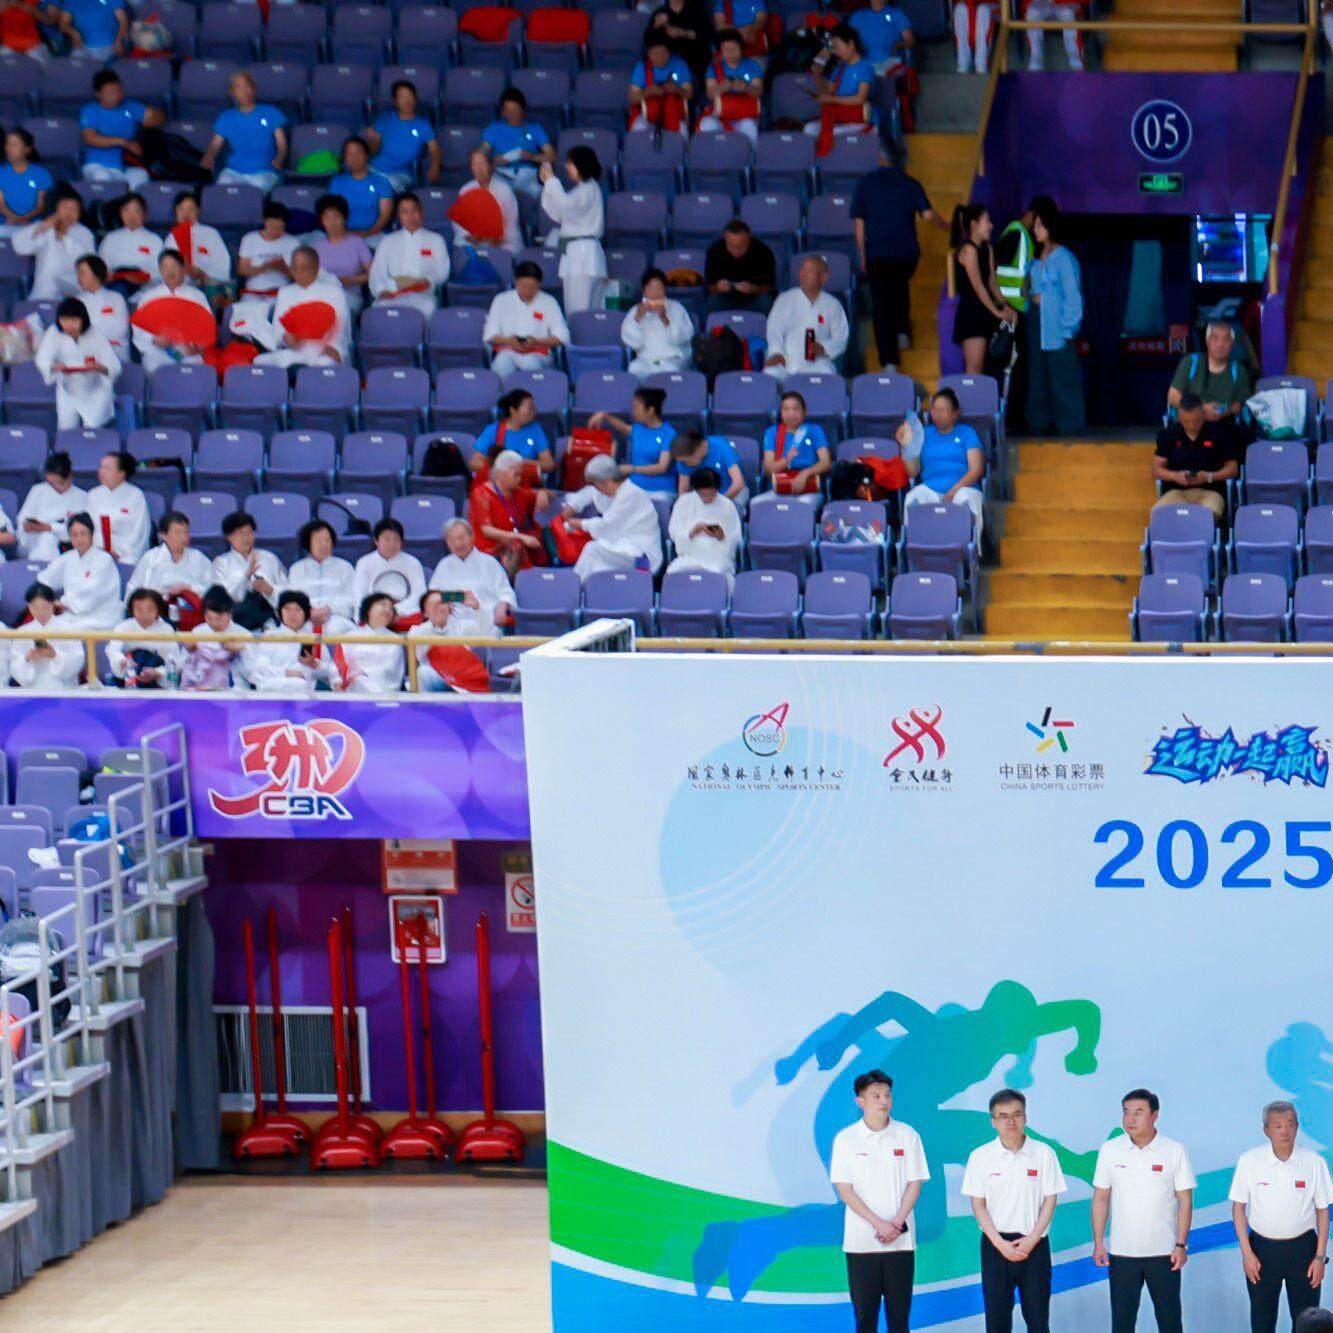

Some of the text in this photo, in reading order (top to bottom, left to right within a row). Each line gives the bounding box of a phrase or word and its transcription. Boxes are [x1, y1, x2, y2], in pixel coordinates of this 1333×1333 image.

[1143, 113, 1179, 150] 05
[1000, 764, 1105, 780] 中国体育彩票
[1001, 783, 1105, 791] CHINA SPORTS LOTTERY
[263, 795, 347, 816] CBA
